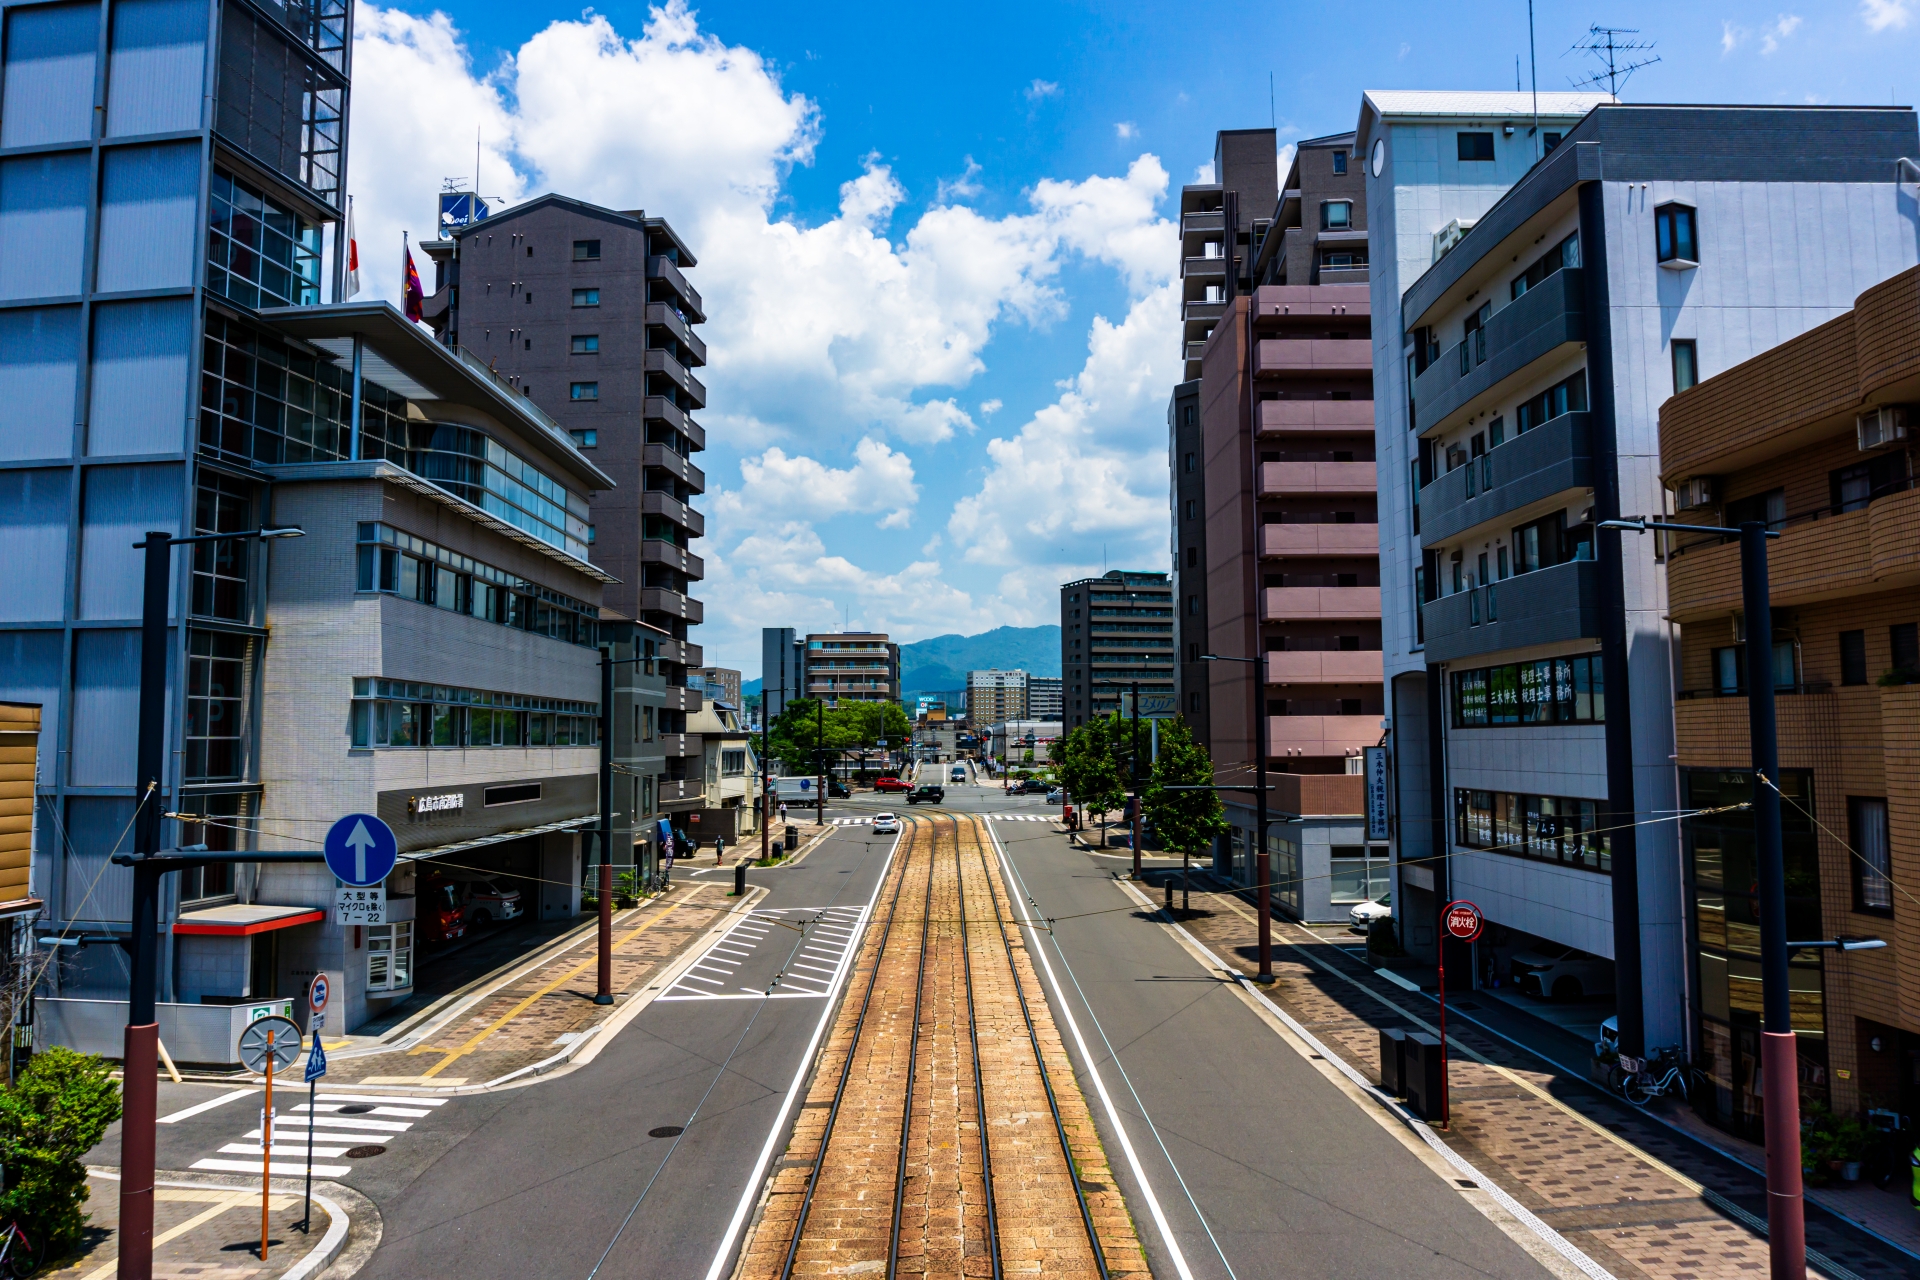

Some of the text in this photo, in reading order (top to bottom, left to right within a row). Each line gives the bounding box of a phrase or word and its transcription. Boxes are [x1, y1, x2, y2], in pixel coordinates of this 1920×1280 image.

[1521, 664, 1571, 685] 税理士事務所
[1139, 697, 1176, 711] ユメリア
[1376, 752, 1386, 835] 三木伸夫税理士事務所
[343, 891, 379, 901] 大型等
[1450, 915, 1475, 929] 消火栓
